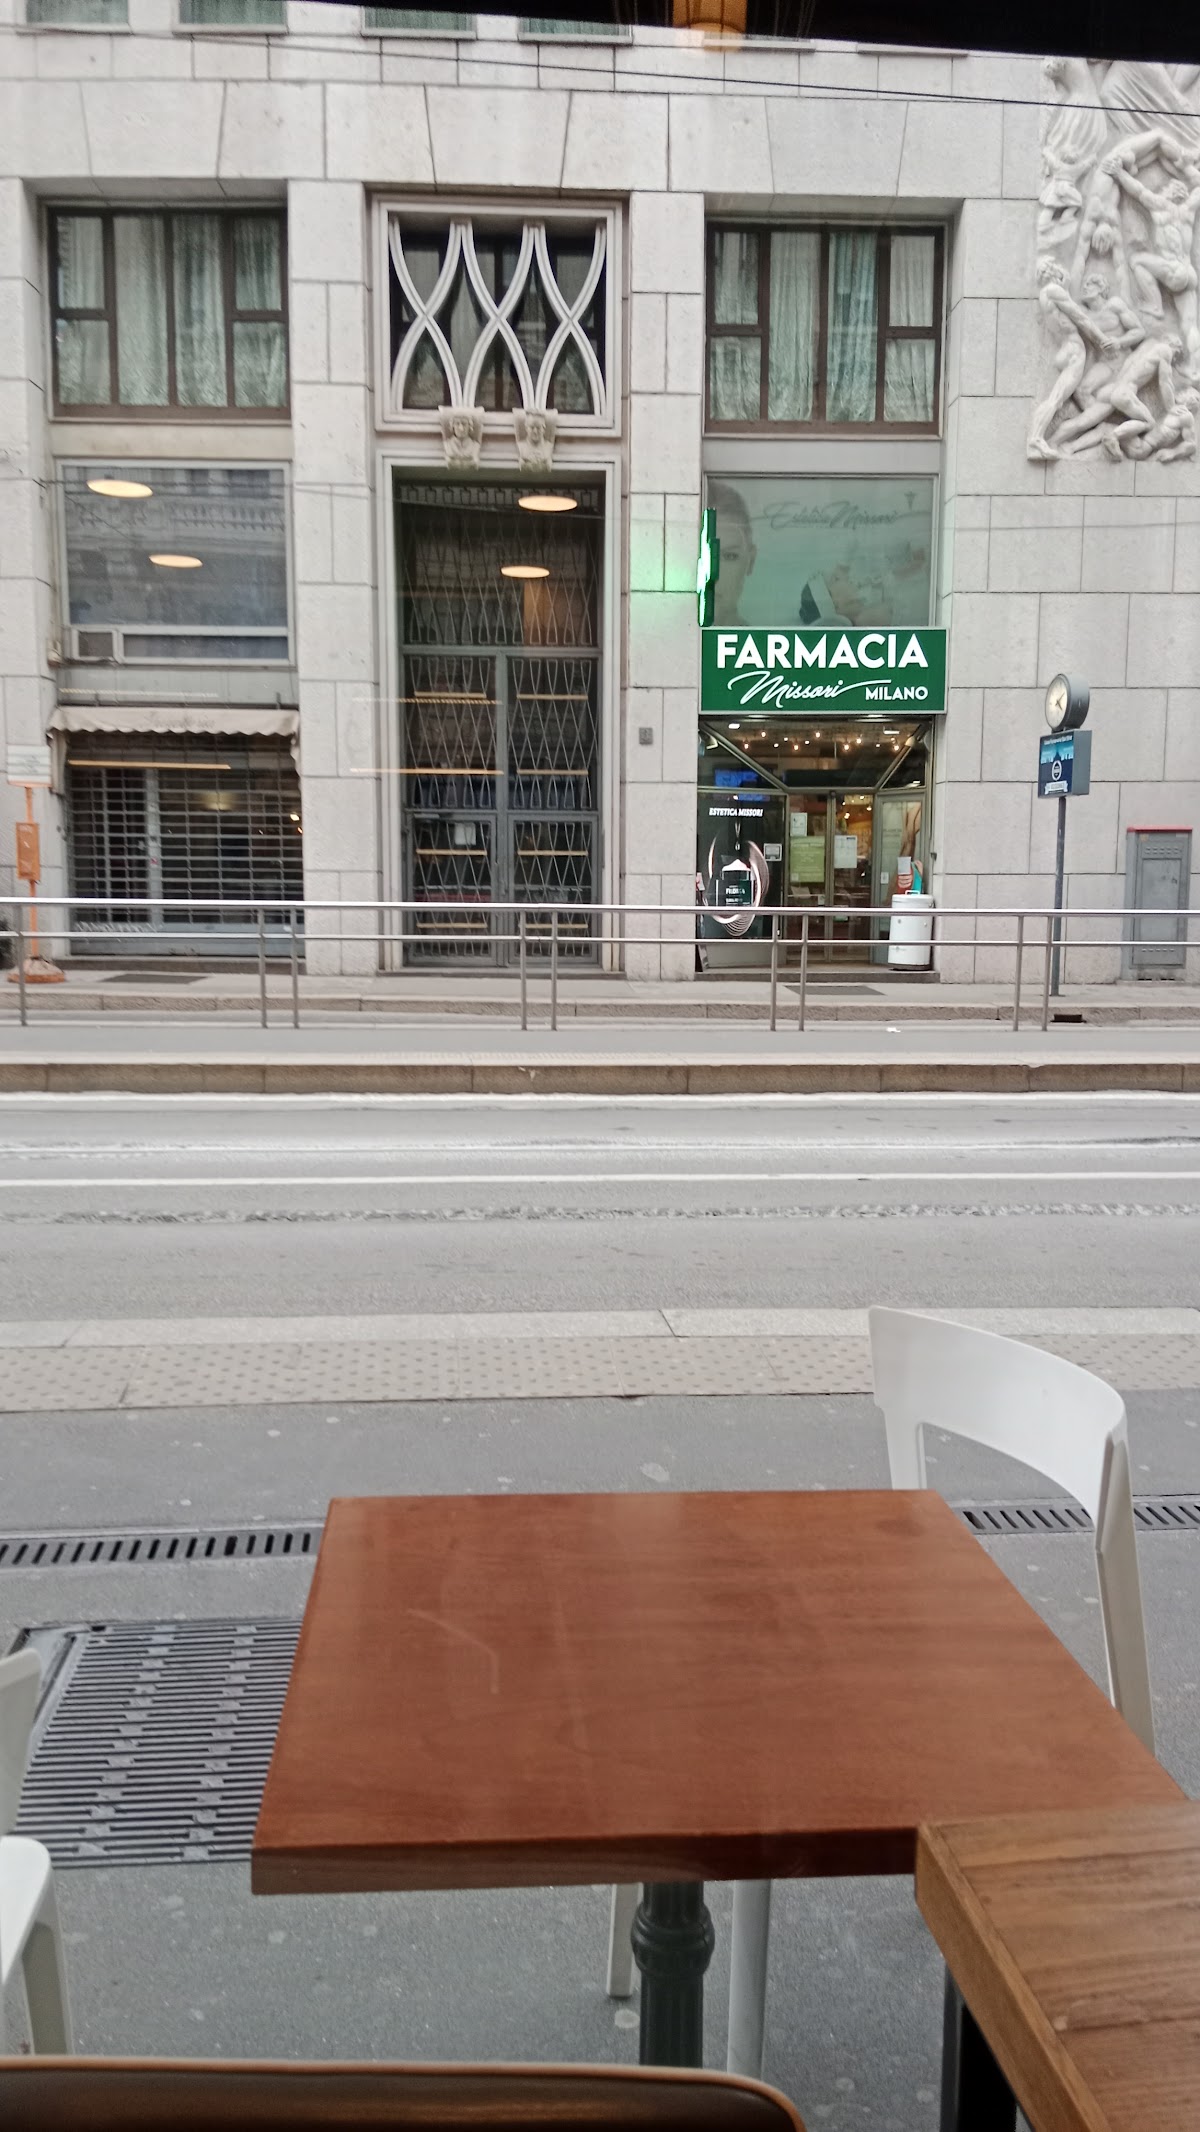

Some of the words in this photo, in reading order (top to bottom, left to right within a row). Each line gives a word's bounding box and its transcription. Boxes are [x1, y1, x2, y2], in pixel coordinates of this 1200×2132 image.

[717, 633, 928, 668] FARMACIA
[727, 671, 892, 708] Missori
[865, 686, 928, 701] MILANO
[709, 807, 738, 817] ESTETICA
[738, 808, 764, 817] MISSORI
